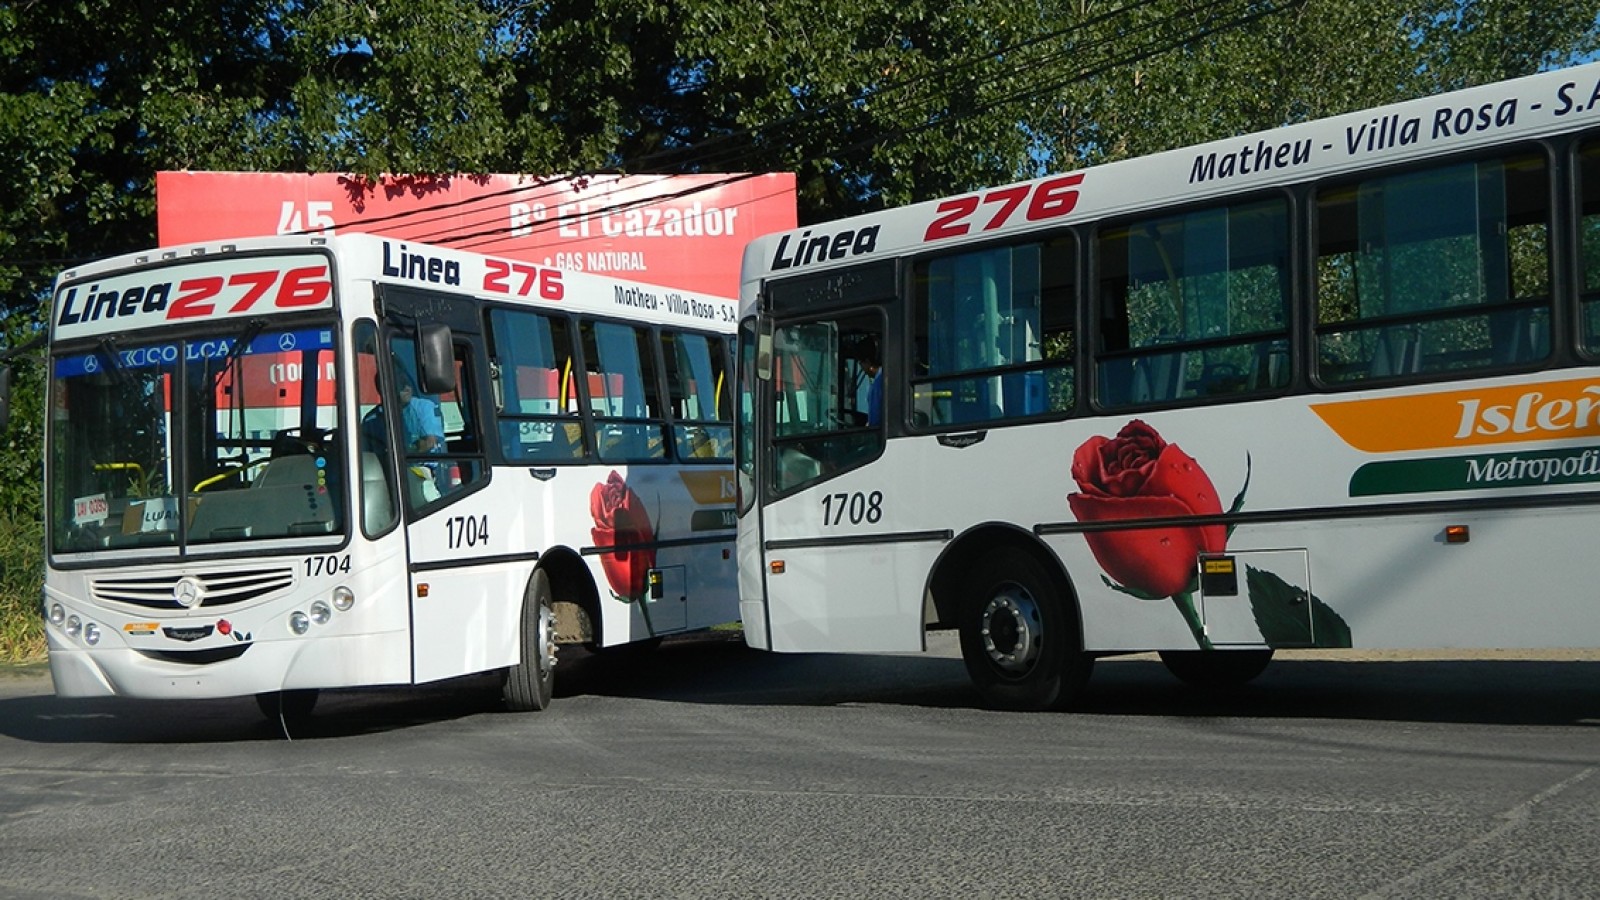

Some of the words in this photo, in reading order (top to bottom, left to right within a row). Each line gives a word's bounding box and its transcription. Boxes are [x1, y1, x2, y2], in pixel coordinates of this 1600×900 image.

[1188, 139, 1312, 184] Matheu
[1346, 114, 1422, 155] Villa
[1431, 98, 1519, 140] Rosa
[276, 200, 336, 236] 45
[558, 202, 590, 237] El
[600, 201, 739, 238] Cazador
[770, 224, 882, 271] Linea
[923, 173, 1086, 243] 276
[382, 241, 461, 287] Linea
[483, 258, 565, 301] 276
[556, 251, 584, 272] GAS
[588, 252, 648, 272] NATURAL
[58, 282, 172, 327] Linea
[165, 265, 332, 321] 276
[614, 285, 658, 311] Matheu
[665, 293, 691, 316] Villa
[691, 298, 715, 319] Rosa
[822, 490, 883, 526] 1708
[445, 514, 489, 549] 1704
[304, 554, 352, 577] 1704
